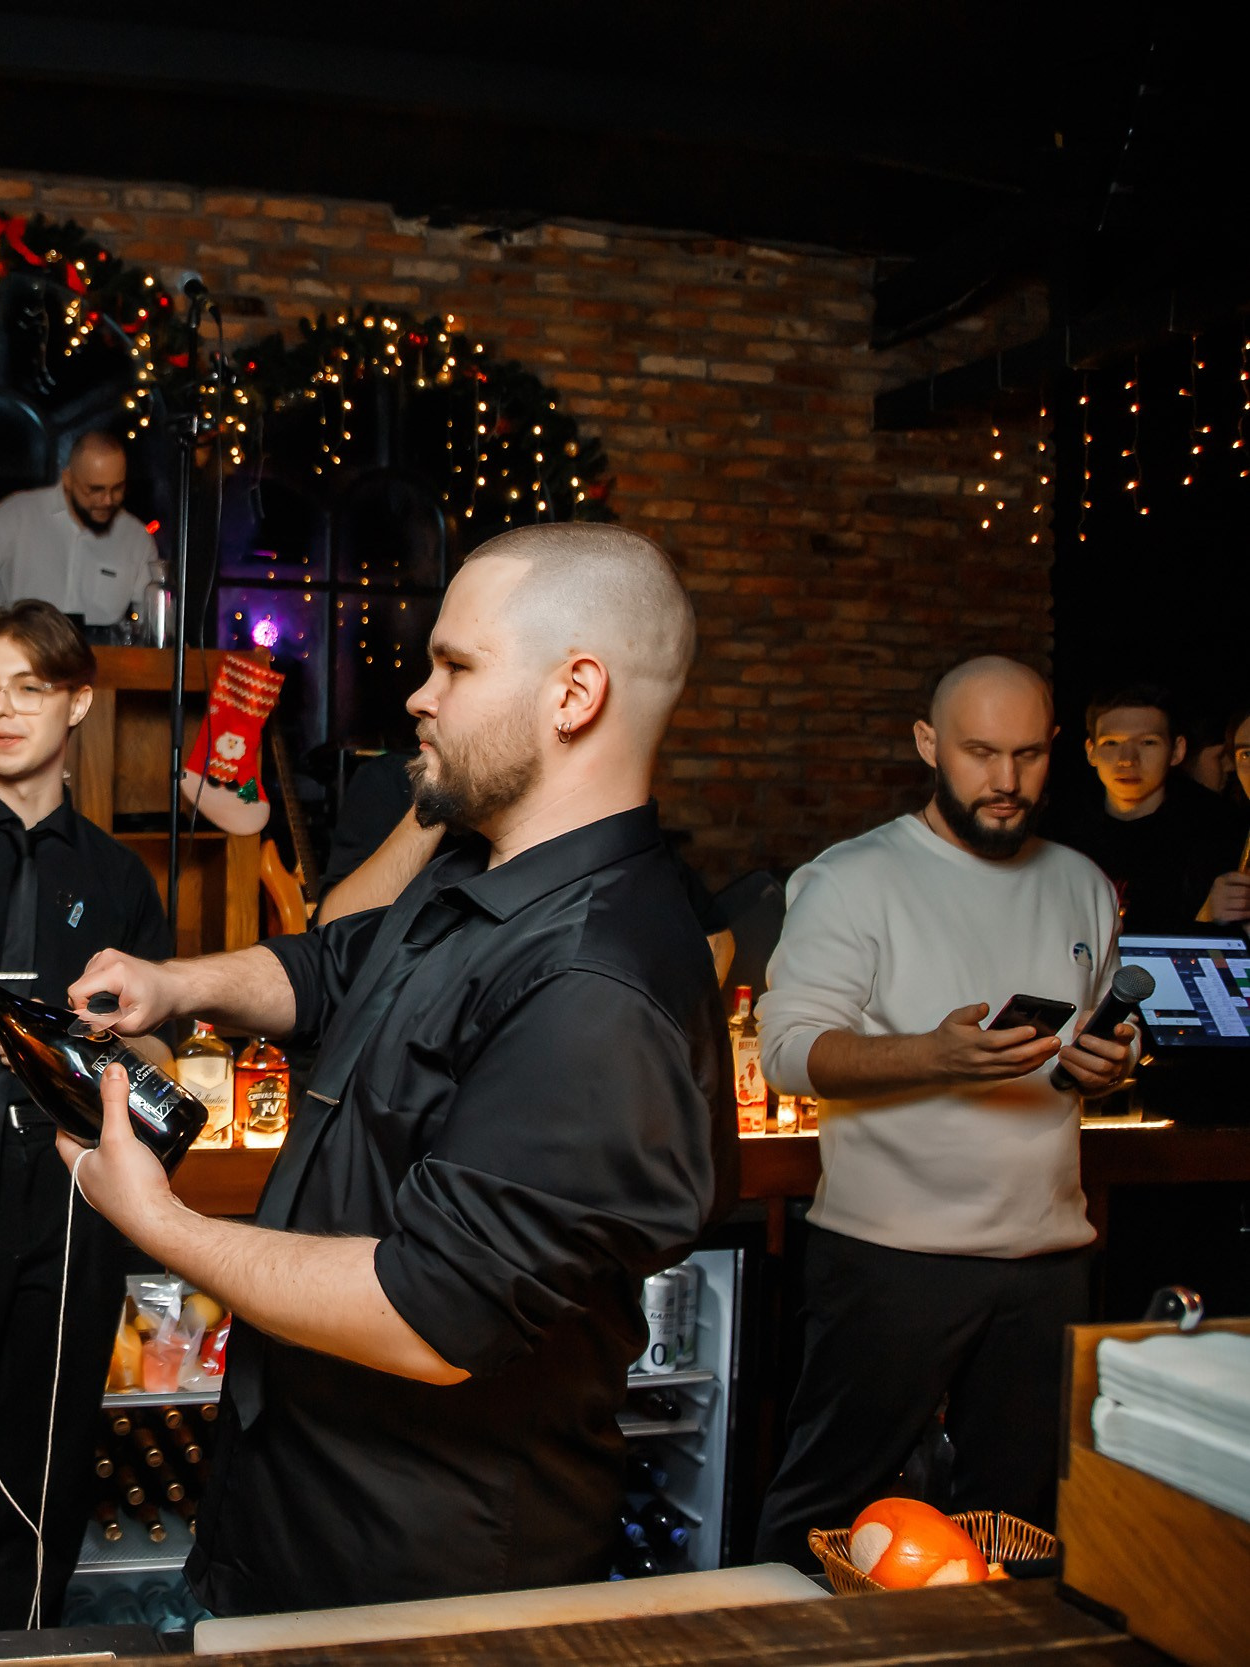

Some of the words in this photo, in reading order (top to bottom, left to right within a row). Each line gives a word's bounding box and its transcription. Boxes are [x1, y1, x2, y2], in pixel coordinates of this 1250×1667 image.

[248, 1092, 272, 1101] CHIVAS
[261, 1100, 281, 1117] XV
[651, 1343, 667, 1367] 0
